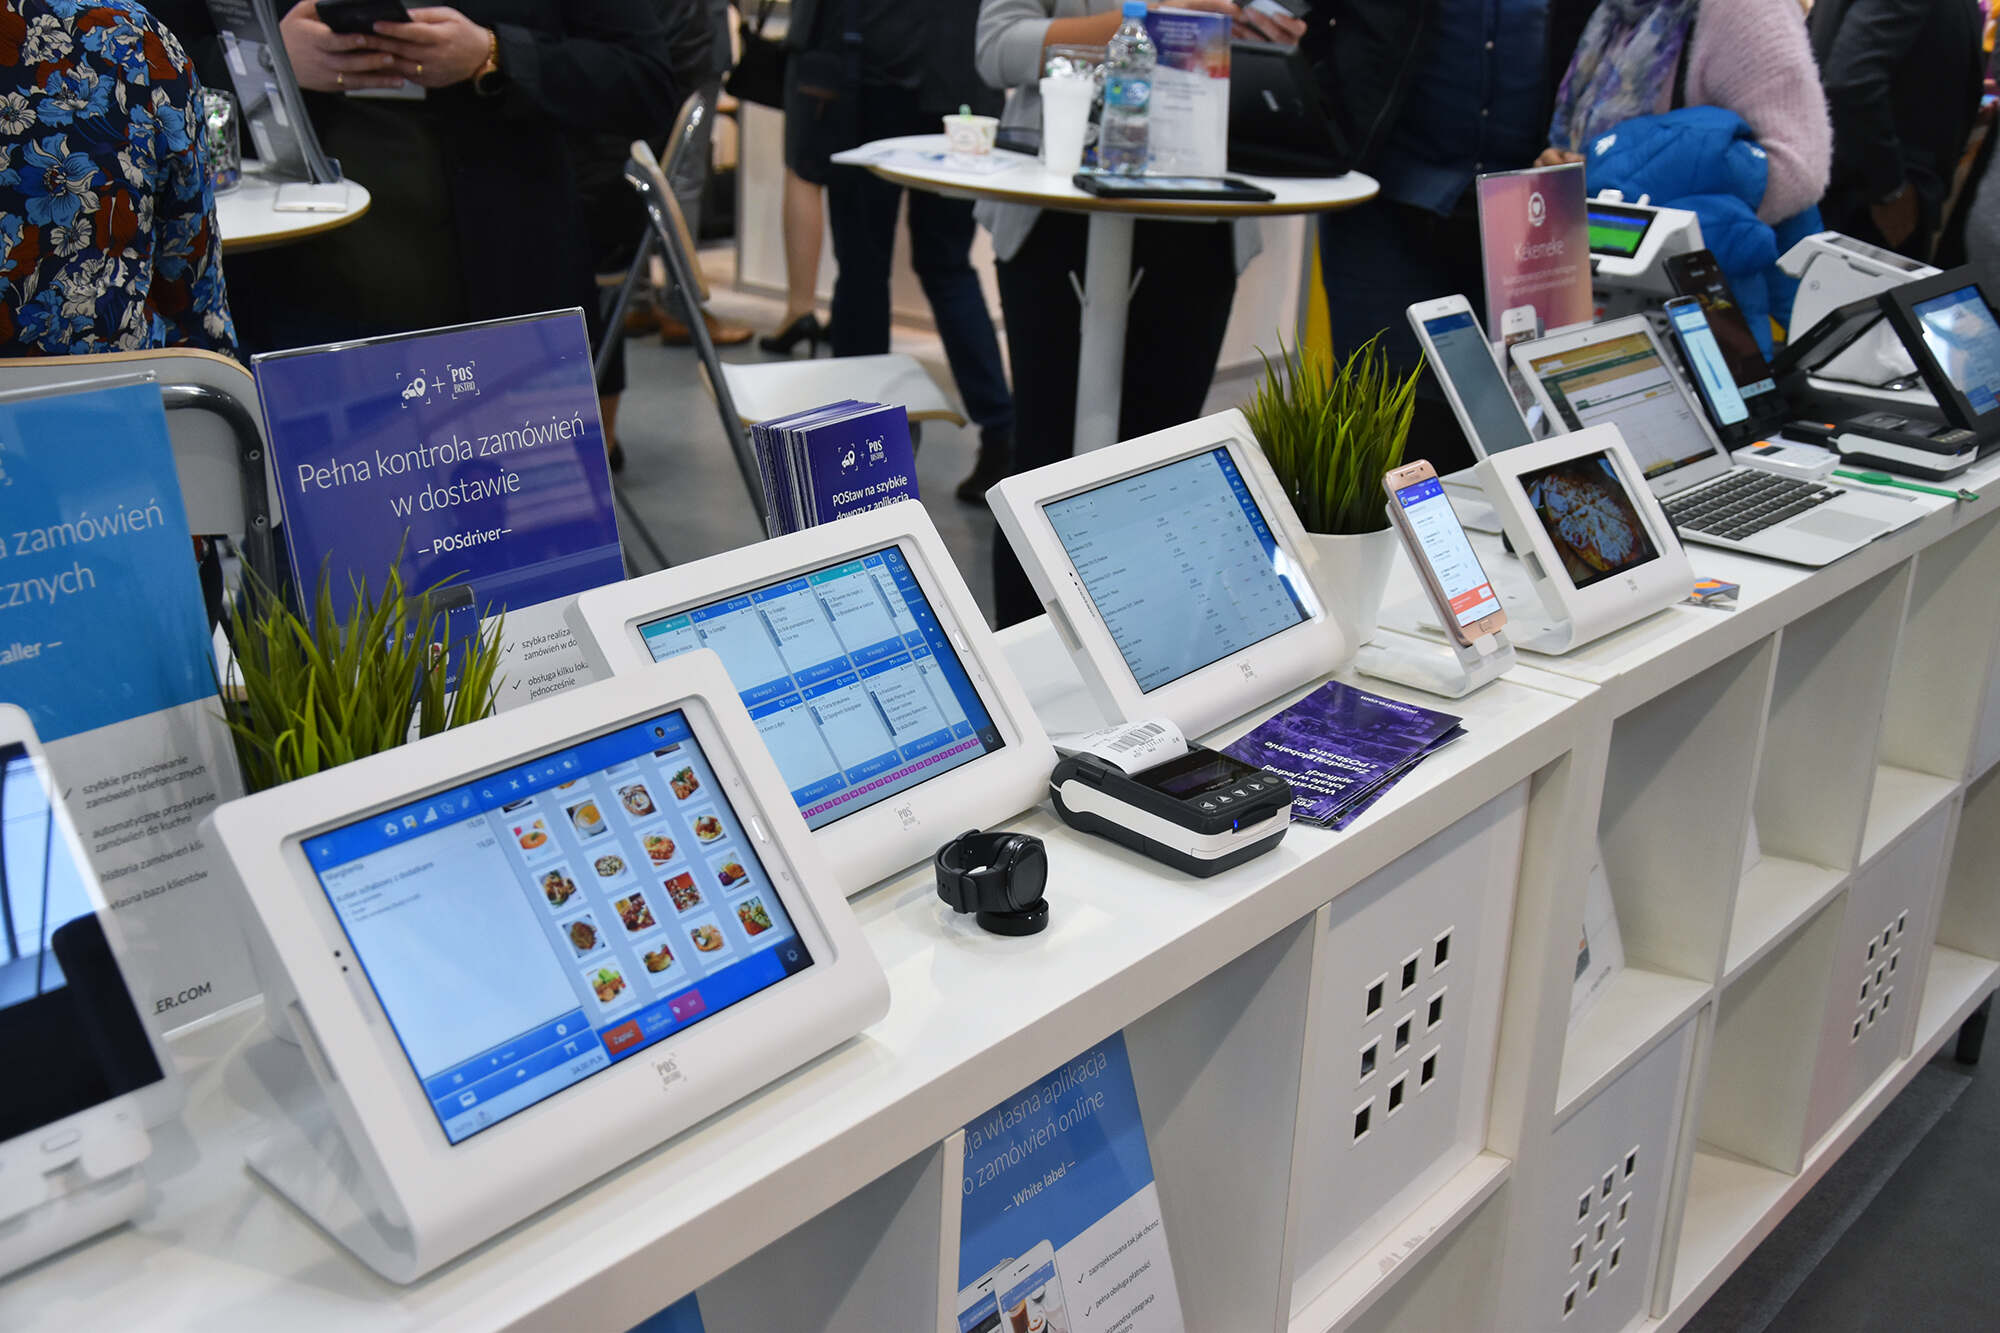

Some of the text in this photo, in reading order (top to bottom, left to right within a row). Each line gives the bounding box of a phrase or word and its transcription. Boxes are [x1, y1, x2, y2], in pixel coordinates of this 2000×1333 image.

[452, 366, 473, 383] POS
[453, 380, 476, 394] BISTRO
[297, 411, 585, 493] Pełna kontrola zamówień
[868, 439, 883, 453] POS
[390, 468, 521, 518] w dostawie
[832, 474, 908, 507] POStaw na szybkie
[12, 497, 164, 556] zamówień
[522, 636, 547, 650] szybka
[524, 644, 560, 661] zamówień
[560, 642, 568, 650] w
[528, 661, 589, 687] obsługa kilku lok
[530, 678, 576, 701] jednocześnie
[1264, 740, 1371, 775] Zarządzaj globalnie
[1309, 747, 1369, 767] POSbistro
[1262, 763, 1346, 791] lokale w jednej
[1286, 778, 1337, 795] Wszystk
[1305, 768, 1355, 784] aplikacji
[153, 981, 212, 1015] ER.COM
[657, 1058, 677, 1076] POS
[984, 1093, 1042, 1141] własna
[1044, 1051, 1108, 1106] aplikacja
[977, 1115, 1057, 1189] zamówień
[1059, 1090, 1106, 1132] online
[1012, 1181, 1043, 1208] White
[1043, 1162, 1067, 1188] label
